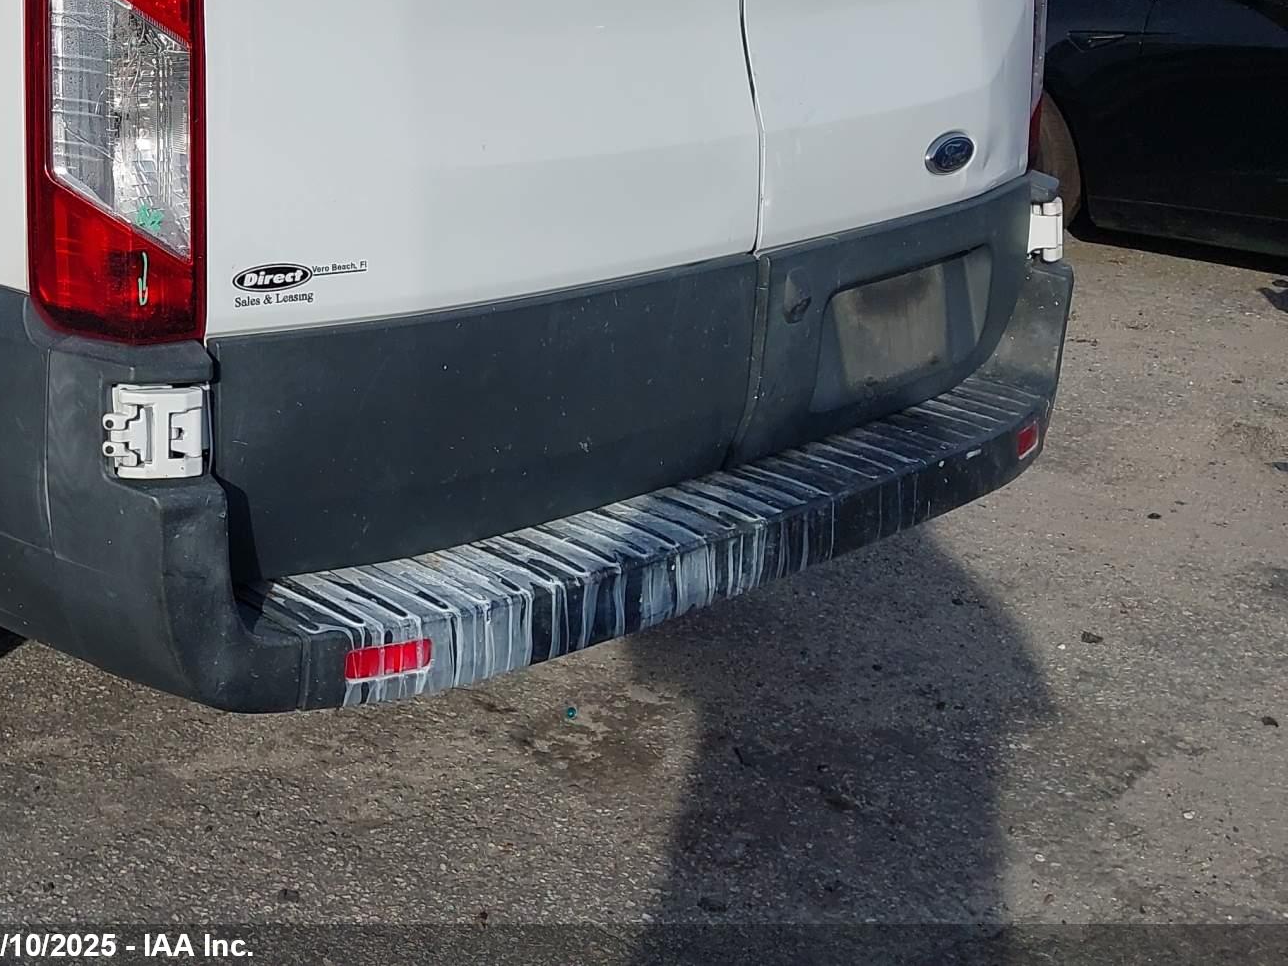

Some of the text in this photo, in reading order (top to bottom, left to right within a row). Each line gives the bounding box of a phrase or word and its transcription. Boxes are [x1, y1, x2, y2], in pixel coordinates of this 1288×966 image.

[243, 269, 304, 287] Direct
[311, 266, 330, 274] Vero
[234, 291, 314, 308] Sales & Leasing
